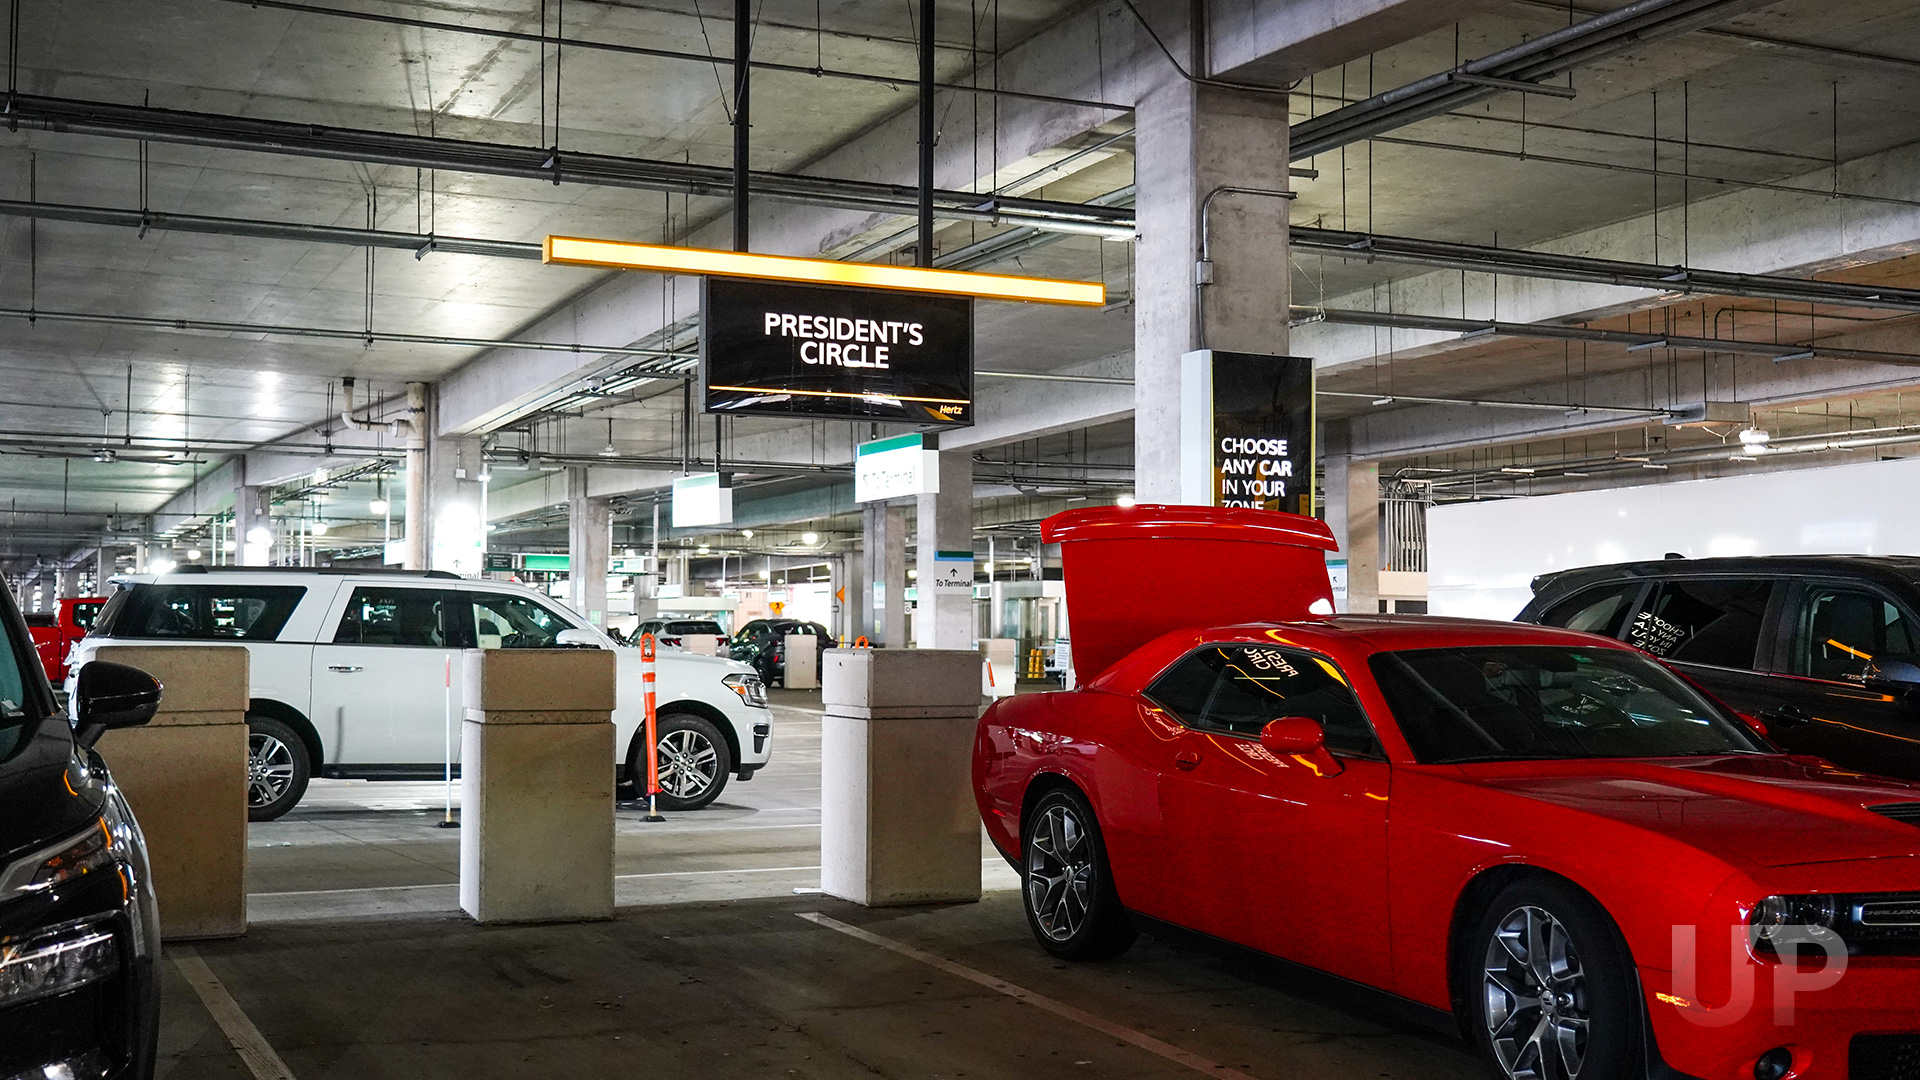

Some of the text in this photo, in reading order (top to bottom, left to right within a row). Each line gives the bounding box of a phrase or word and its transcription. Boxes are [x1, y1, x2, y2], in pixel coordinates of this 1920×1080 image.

[764, 312, 924, 346] PRESIDENT'S
[800, 342, 890, 369] CIRCLE
[940, 405, 963, 415] Hertz
[1221, 437, 1288, 456] CHOOSE
[1221, 458, 1293, 477] ANY CAR
[1222, 479, 1286, 497] IN YOUR
[936, 579, 973, 588] To Terminal
